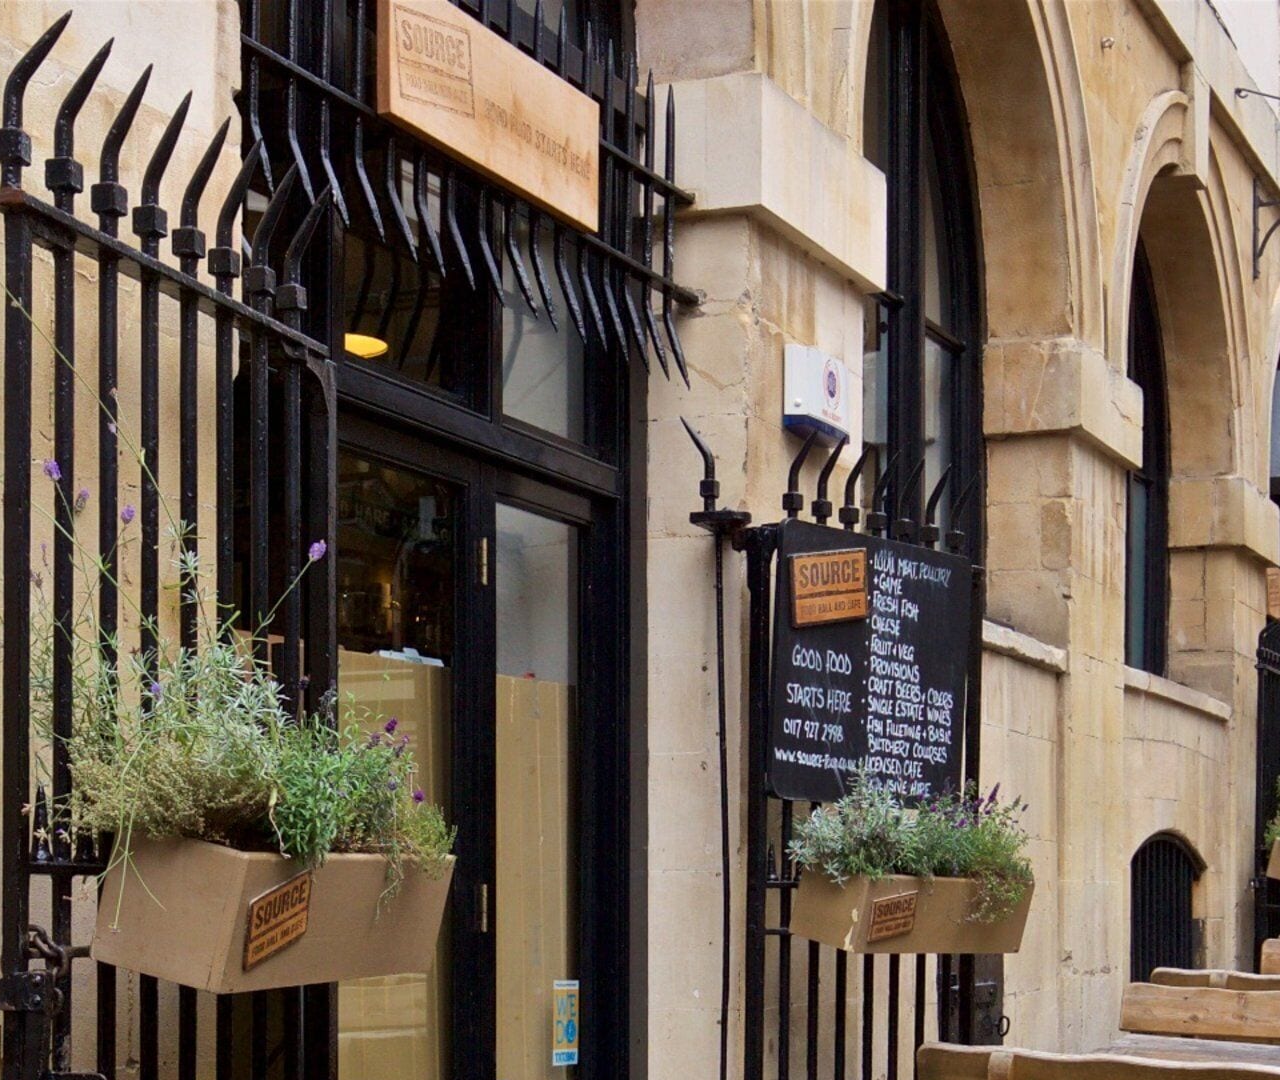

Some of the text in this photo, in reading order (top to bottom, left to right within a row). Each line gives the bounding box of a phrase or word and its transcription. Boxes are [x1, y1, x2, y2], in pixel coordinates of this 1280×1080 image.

[401, 19, 466, 70] SOURCE
[535, 130, 568, 166] STARTS
[799, 559, 860, 588] SOURCE
[873, 591, 919, 622] FRESH FISH
[872, 615, 900, 636] CHEESE
[792, 644, 852, 675] GOOD FOOD
[870, 634, 893, 656] FRUIT
[898, 643, 914, 662] VEG
[870, 656, 920, 682] PROVISIONS
[786, 683, 852, 713] STARTS HERE
[868, 676, 893, 695] CRAFT
[895, 680, 920, 703] BEERS
[927, 688, 953, 709] CIDERS
[867, 715, 883, 737] FISH
[868, 695, 952, 727] SINGLE ESTATE WINES
[783, 718, 801, 739] 0117
[804, 721, 819, 741] 927
[868, 733, 947, 765] BUTCHERY COURSES
[865, 755, 923, 778] LICENSED CAFE
[256, 882, 306, 929] SOURCE
[877, 898, 914, 918] SOURCE
